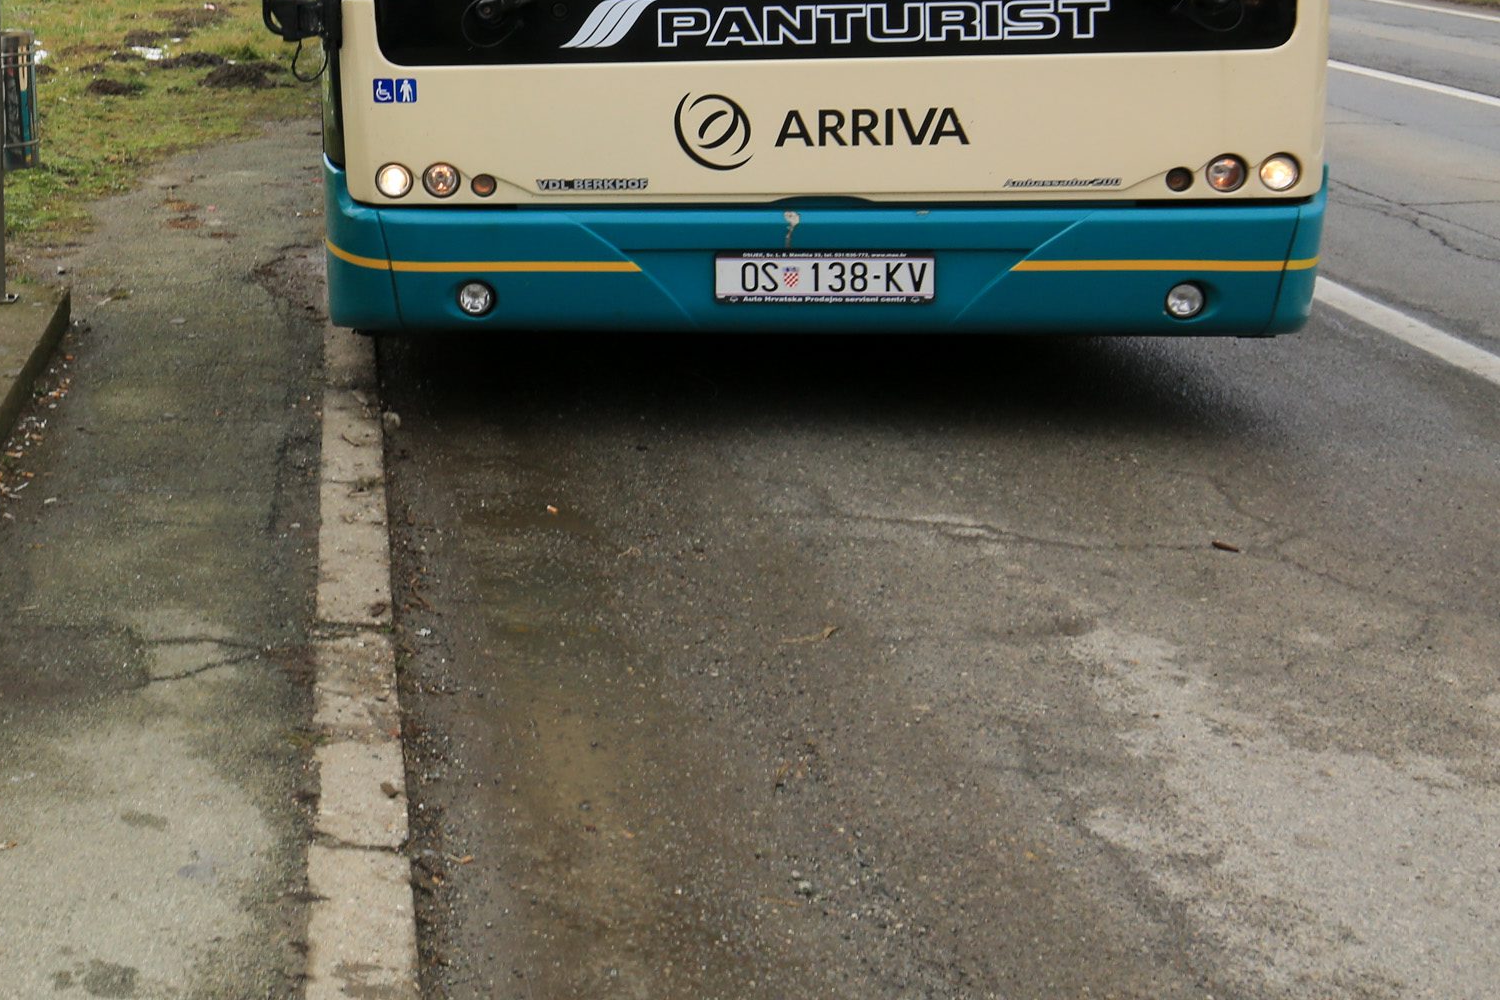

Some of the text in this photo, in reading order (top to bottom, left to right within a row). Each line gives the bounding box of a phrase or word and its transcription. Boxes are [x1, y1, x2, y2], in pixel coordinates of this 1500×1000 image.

[774, 107, 971, 148] ARRIVA
[536, 178, 649, 191] VDL BERKHOF
[741, 262, 927, 292] OS 138-KV
